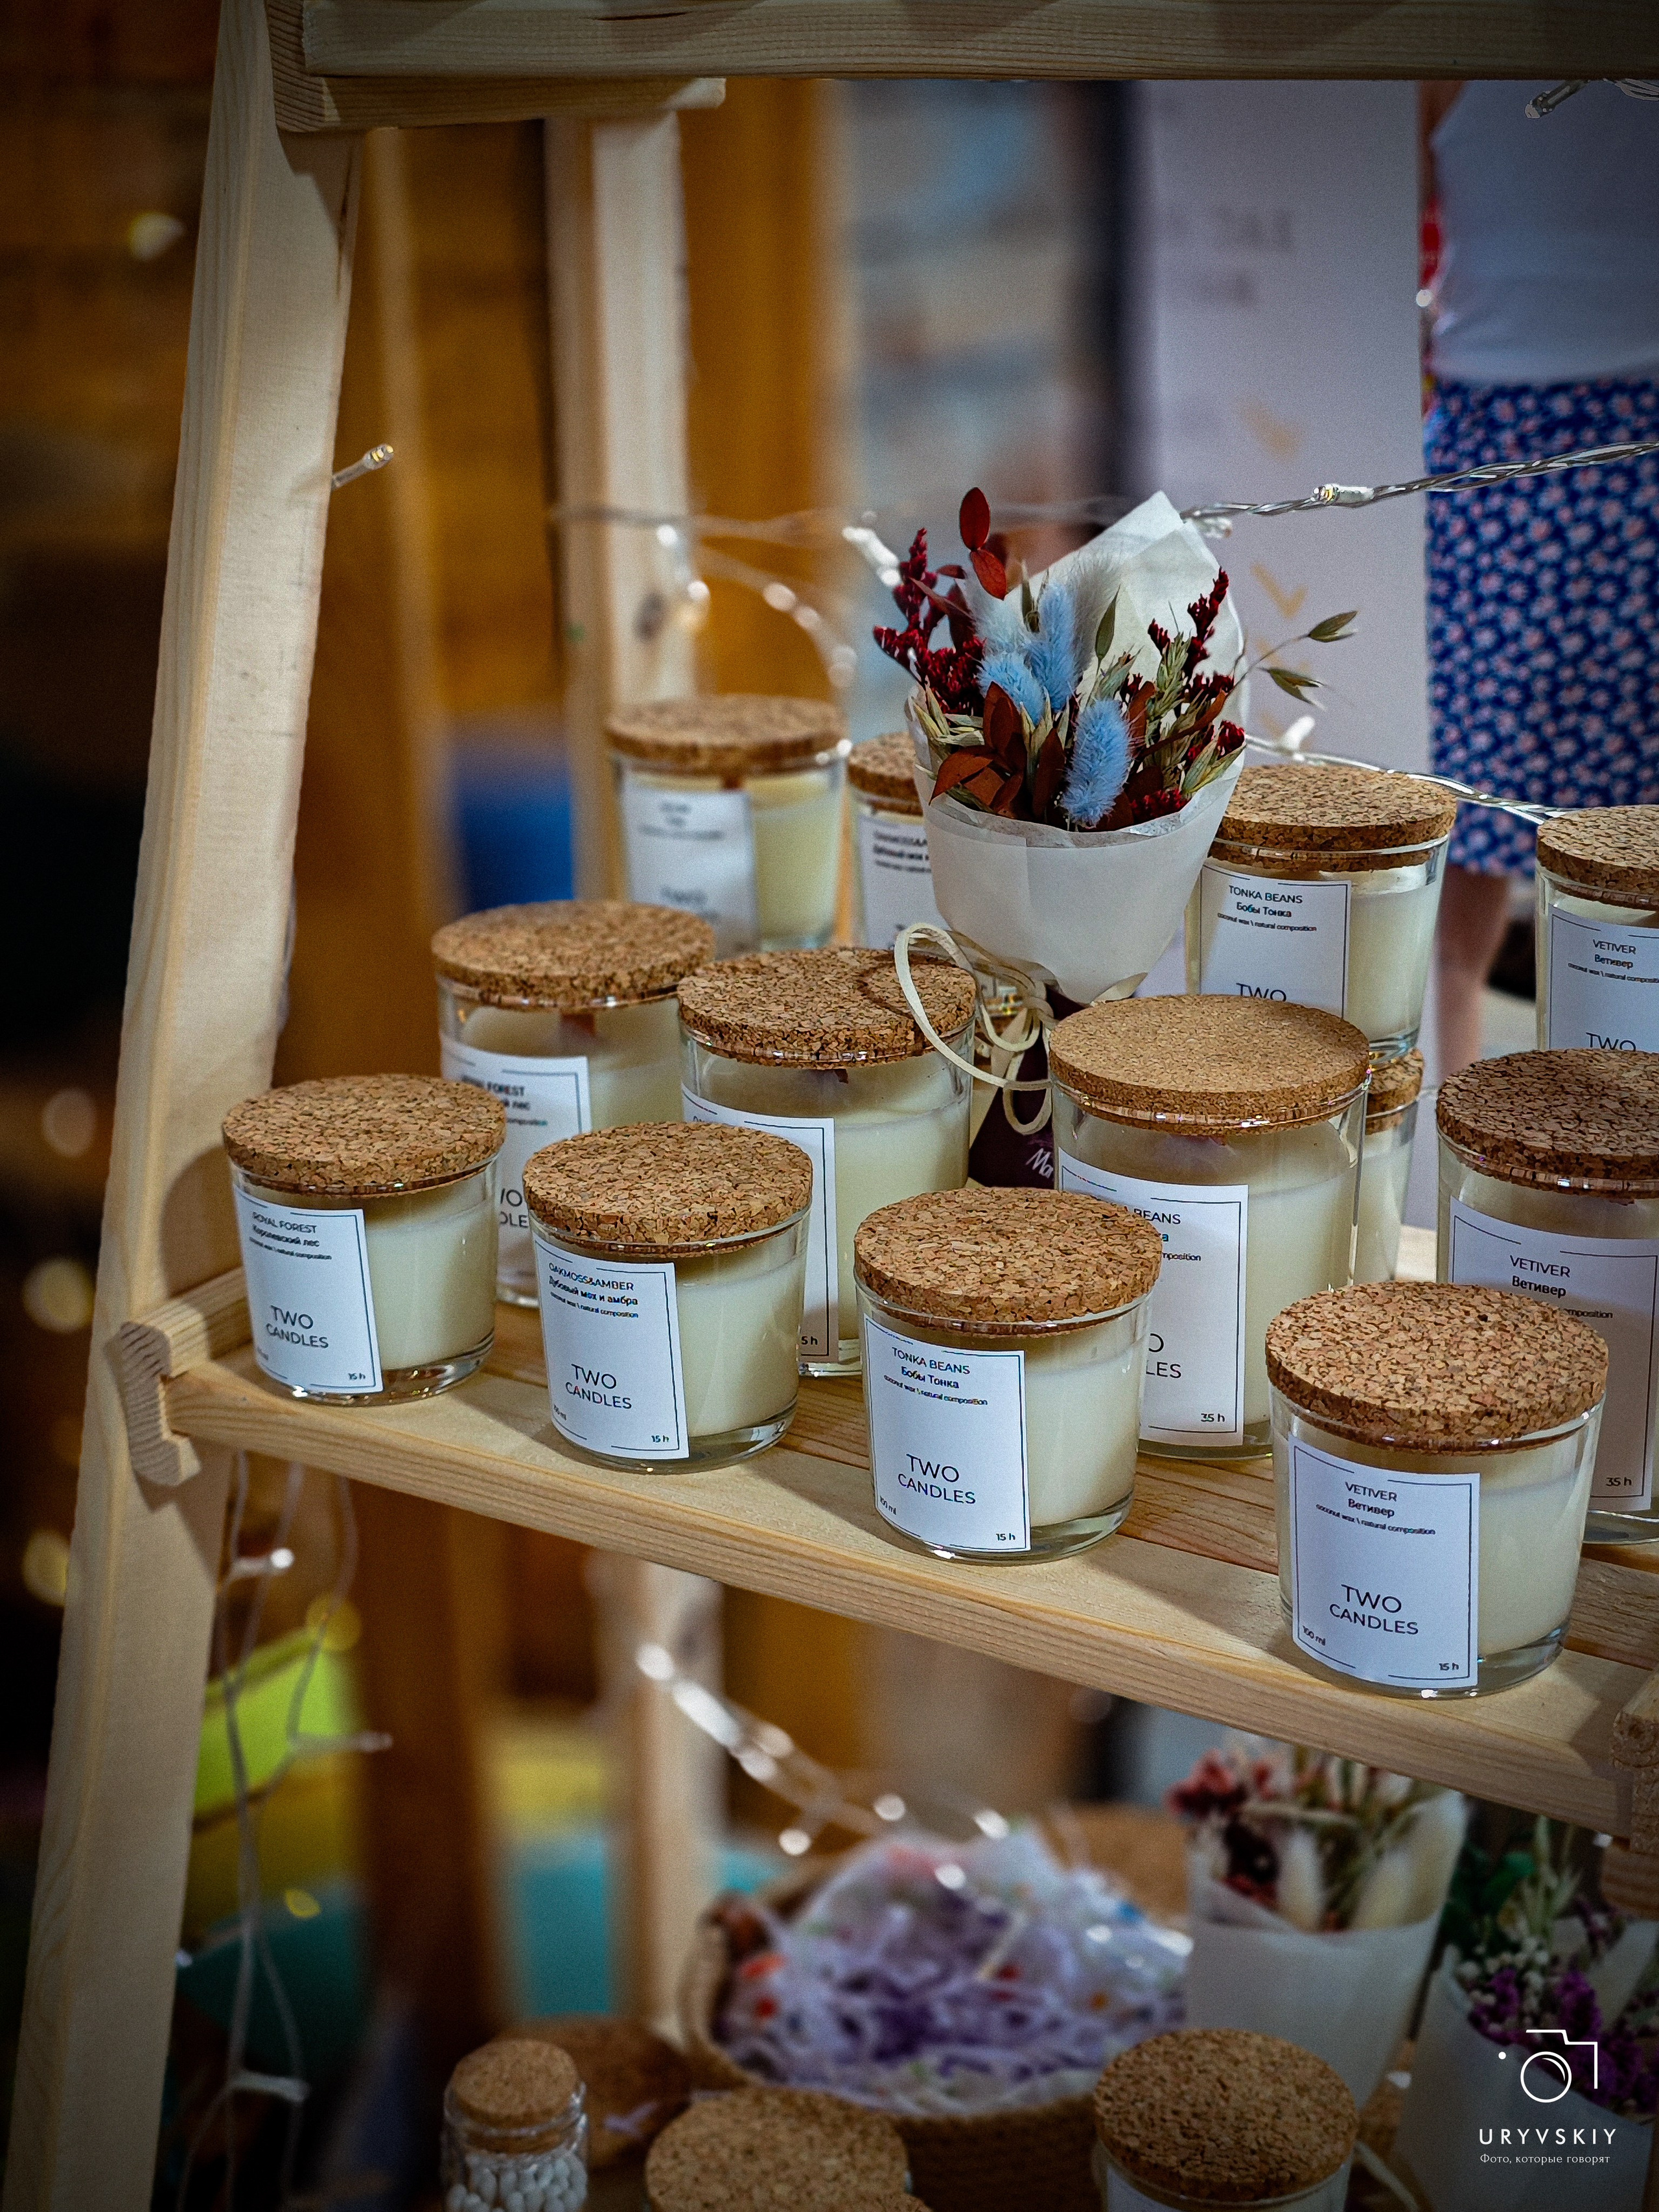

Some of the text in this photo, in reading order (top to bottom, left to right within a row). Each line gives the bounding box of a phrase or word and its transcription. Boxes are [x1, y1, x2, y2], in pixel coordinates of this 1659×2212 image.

[1229, 885, 1303, 903] TONKA BEANS
[1236, 902, 1292, 917] Бобы Тонка
[1592, 938, 1636, 955] VETIVER
[1585, 1031, 1636, 1051] TWO
[279, 1220, 318, 1234] FOREST
[548, 1262, 634, 1291] OAKMOSS&AMBER
[1509, 1255, 1571, 1278] VETIVER
[1512, 1275, 1566, 1299] Ветивер
[581, 1290, 597, 1301] мох
[607, 1295, 638, 1307] амбра
[270, 1305, 314, 1329] TWO
[266, 1323, 329, 1349] CANDLES
[810, 1336, 818, 1345] h
[892, 1346, 970, 1375] TONKA BEANS
[570, 1363, 617, 1389] TWO
[901, 1366, 959, 1389] Бобы Тонка
[565, 1381, 632, 1410] CANDLES
[1201, 1413, 1225, 1422] 35 h
[651, 1434, 662, 1443] 15
[905, 1454, 960, 1483] TWO
[898, 1473, 976, 1504] CANDLES
[1345, 1481, 1397, 1502] VETIVER
[1605, 1476, 1632, 1487] 35 h
[1348, 1498, 1395, 1519] Ветивер
[995, 1532, 1015, 1541] 15 h
[1387, 1525, 1436, 1535] composition
[1341, 1584, 1402, 1614] TWO
[1329, 1603, 1419, 1635] CANDLES
[1303, 1625, 1326, 1646] 100 ml
[1439, 1662, 1450, 1671] 15
